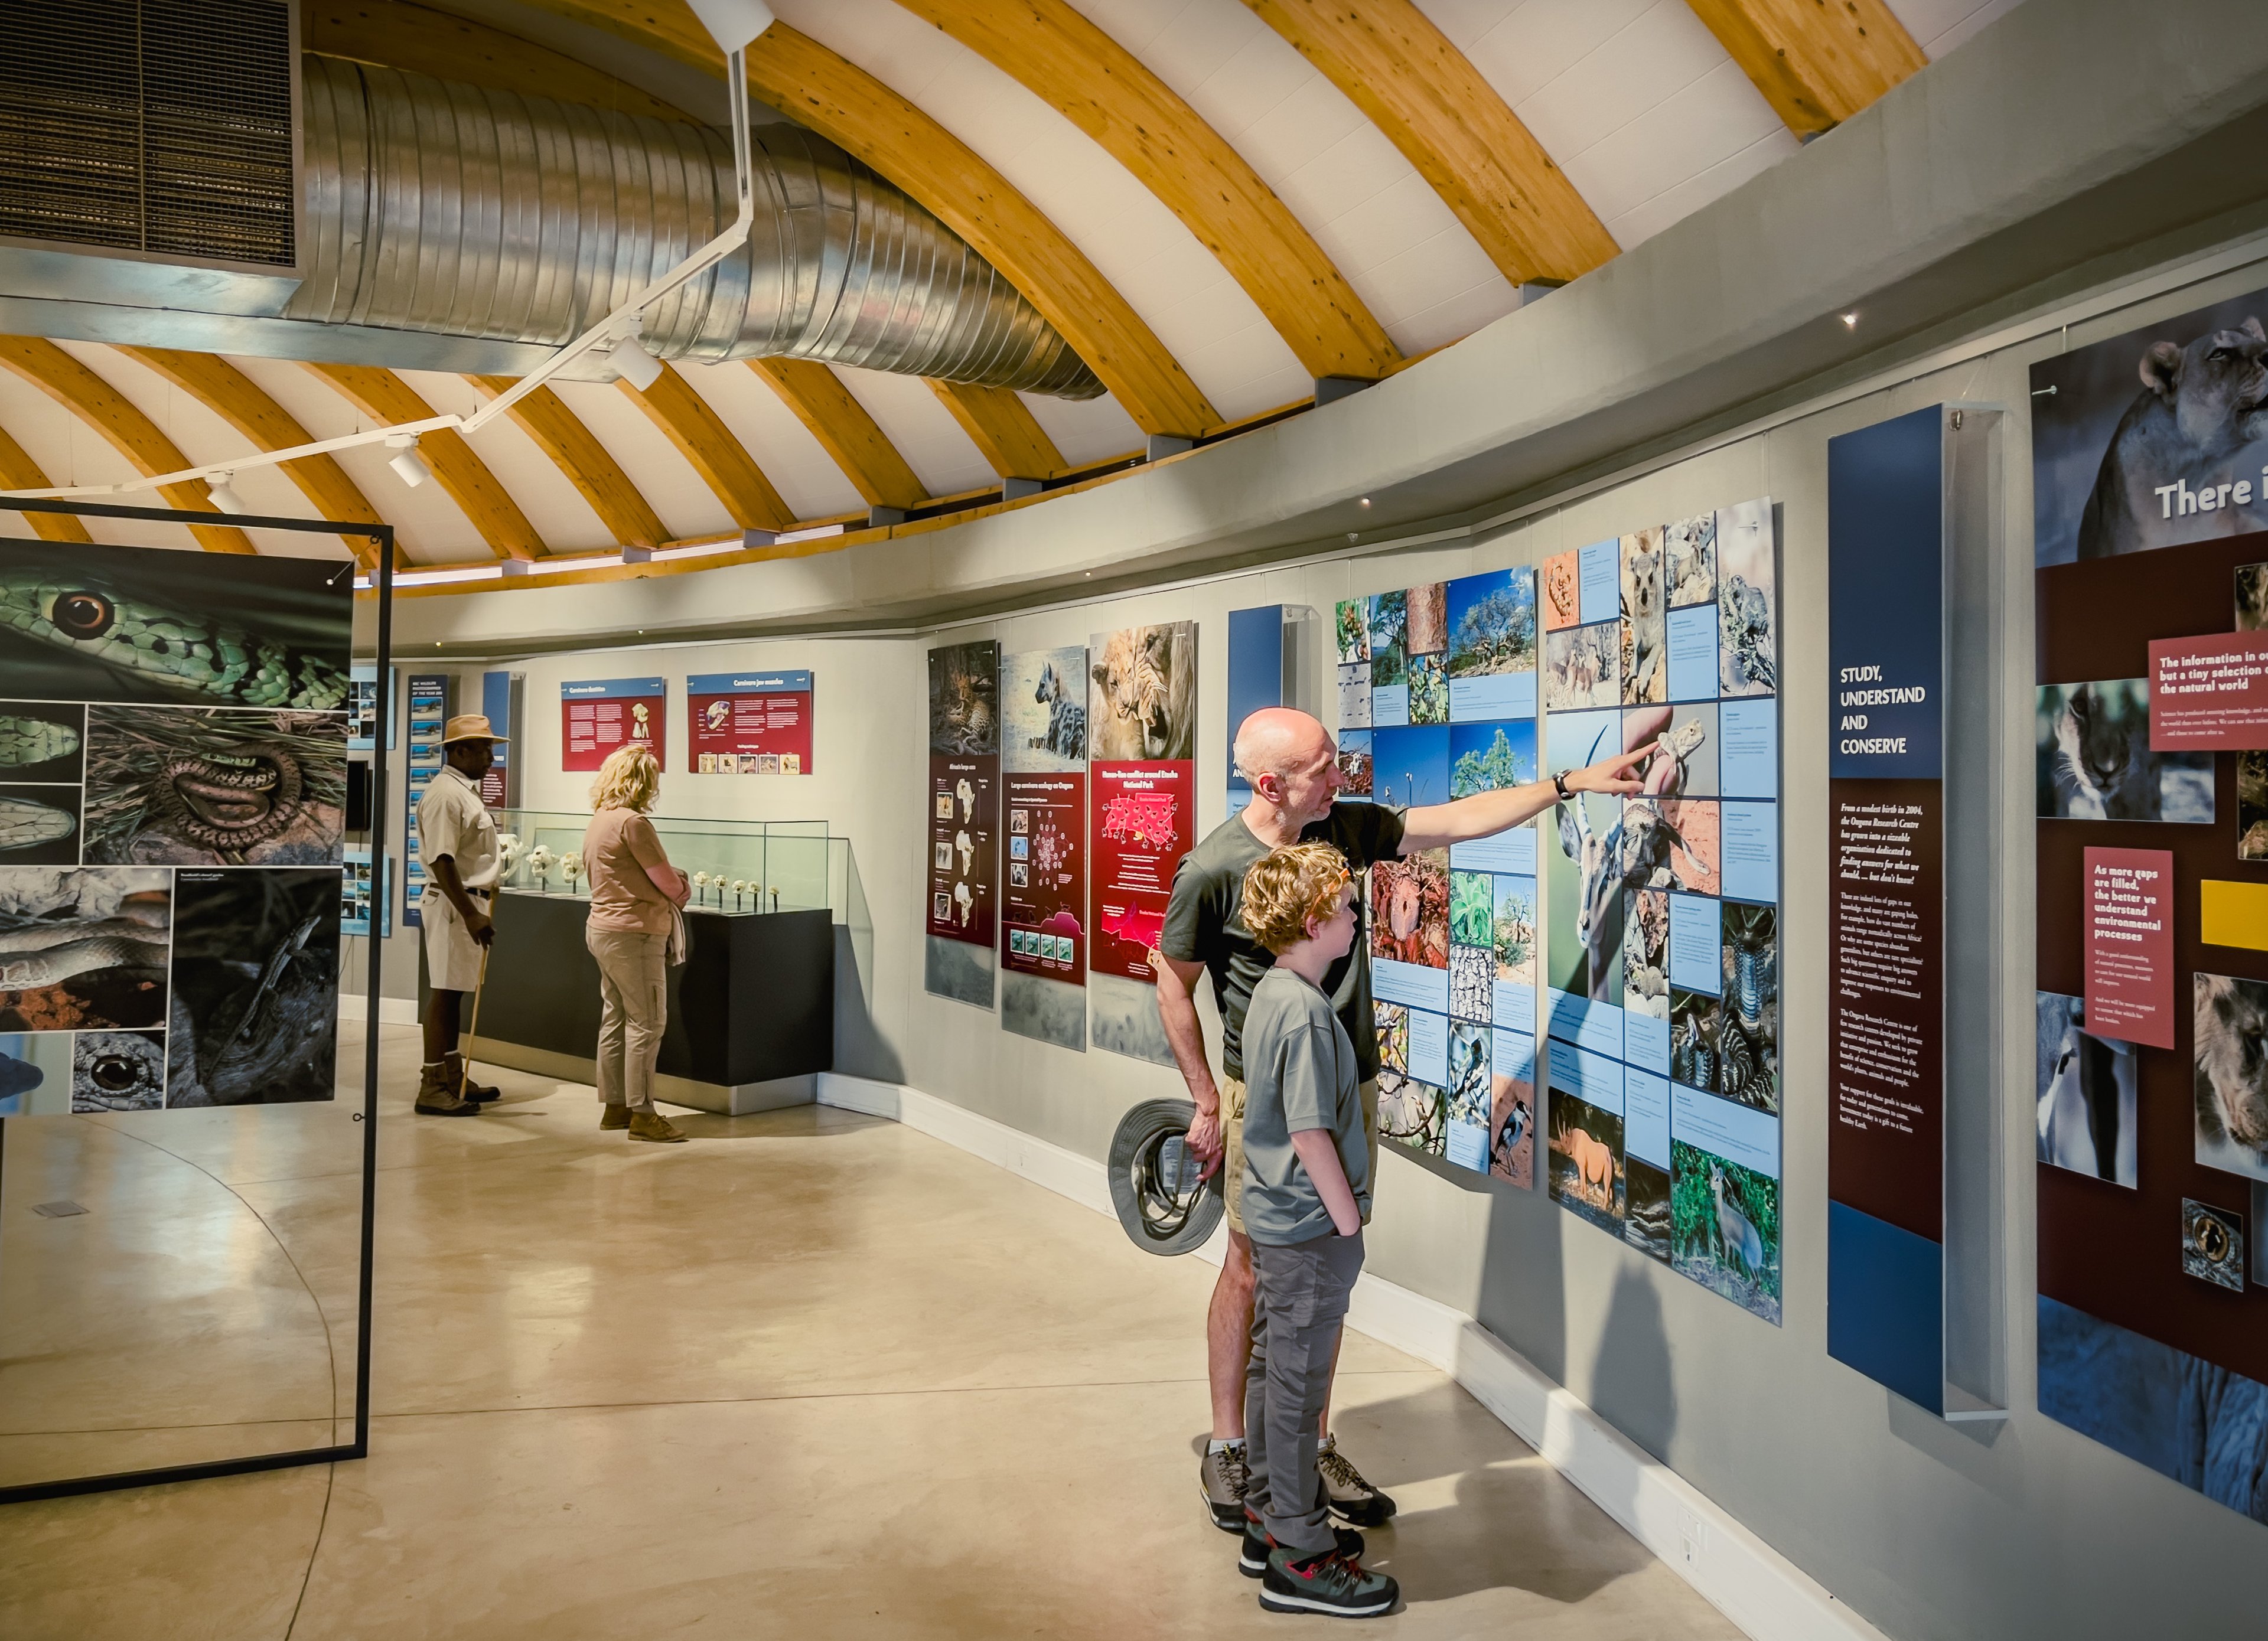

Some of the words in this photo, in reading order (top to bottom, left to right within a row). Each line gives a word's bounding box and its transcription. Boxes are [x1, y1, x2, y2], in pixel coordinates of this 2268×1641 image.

[2155, 478, 2252, 518] There
[2160, 657, 2179, 668] The
[2181, 653, 2242, 666] information
[2246, 651, 2256, 661] in
[1841, 665, 1882, 683] STUDY,
[2160, 670, 2177, 681] but
[2189, 669, 2208, 681] tiny
[2212, 665, 2262, 678] selection
[2161, 683, 2176, 694] the
[2179, 680, 2215, 693] natural
[2218, 678, 2249, 690] world
[1841, 687, 1925, 706] UNDERSTAND
[1841, 715, 1868, 730] AND
[1841, 738, 1906, 753] CONSERVE
[1233, 769, 1244, 777] AN
[2094, 864, 2107, 875] As
[2109, 868, 2132, 876] more
[2135, 870, 2158, 880] gaps
[2094, 889, 2109, 900] the
[2111, 890, 2141, 902] better
[2094, 902, 2148, 916] understand
[2094, 916, 2161, 930] environmental
[2094, 929, 2142, 941] processes
